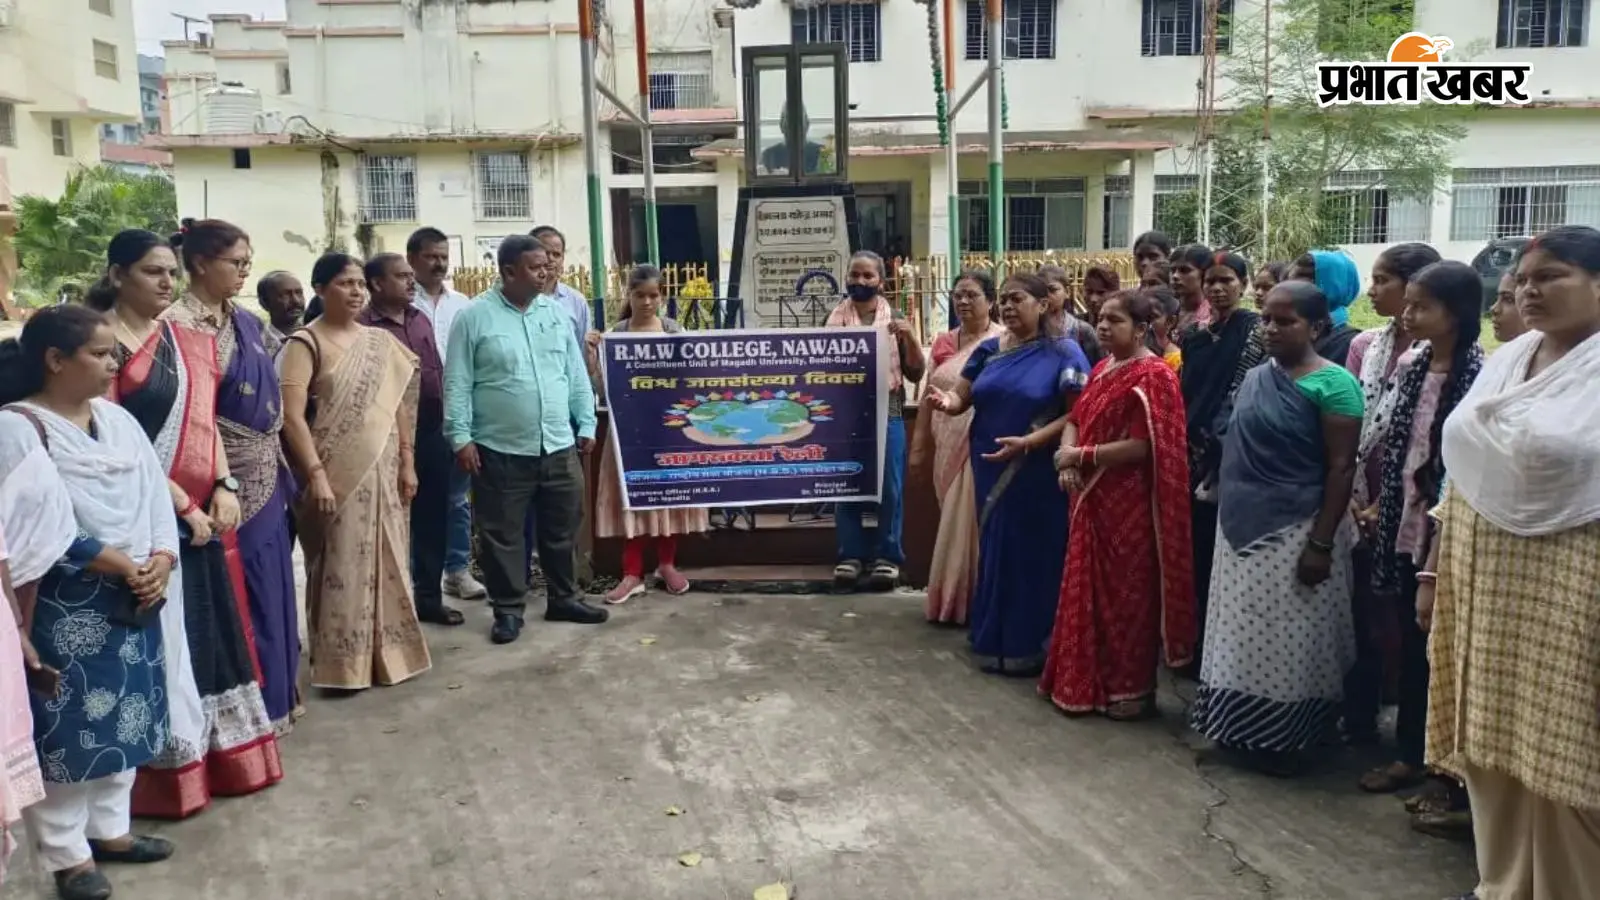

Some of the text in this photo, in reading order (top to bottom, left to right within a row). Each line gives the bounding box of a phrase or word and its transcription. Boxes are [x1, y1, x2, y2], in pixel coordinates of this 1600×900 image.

[614, 337, 870, 361] R.M.W COLLEGE, NAWADA
[634, 360, 687, 369] Constituent
[689, 359, 708, 368] Unit
[710, 359, 719, 368] of
[721, 358, 757, 368] Magadh
[759, 356, 807, 366] University,
[629, 371, 867, 390] विश्व जनसंख्या दिवस
